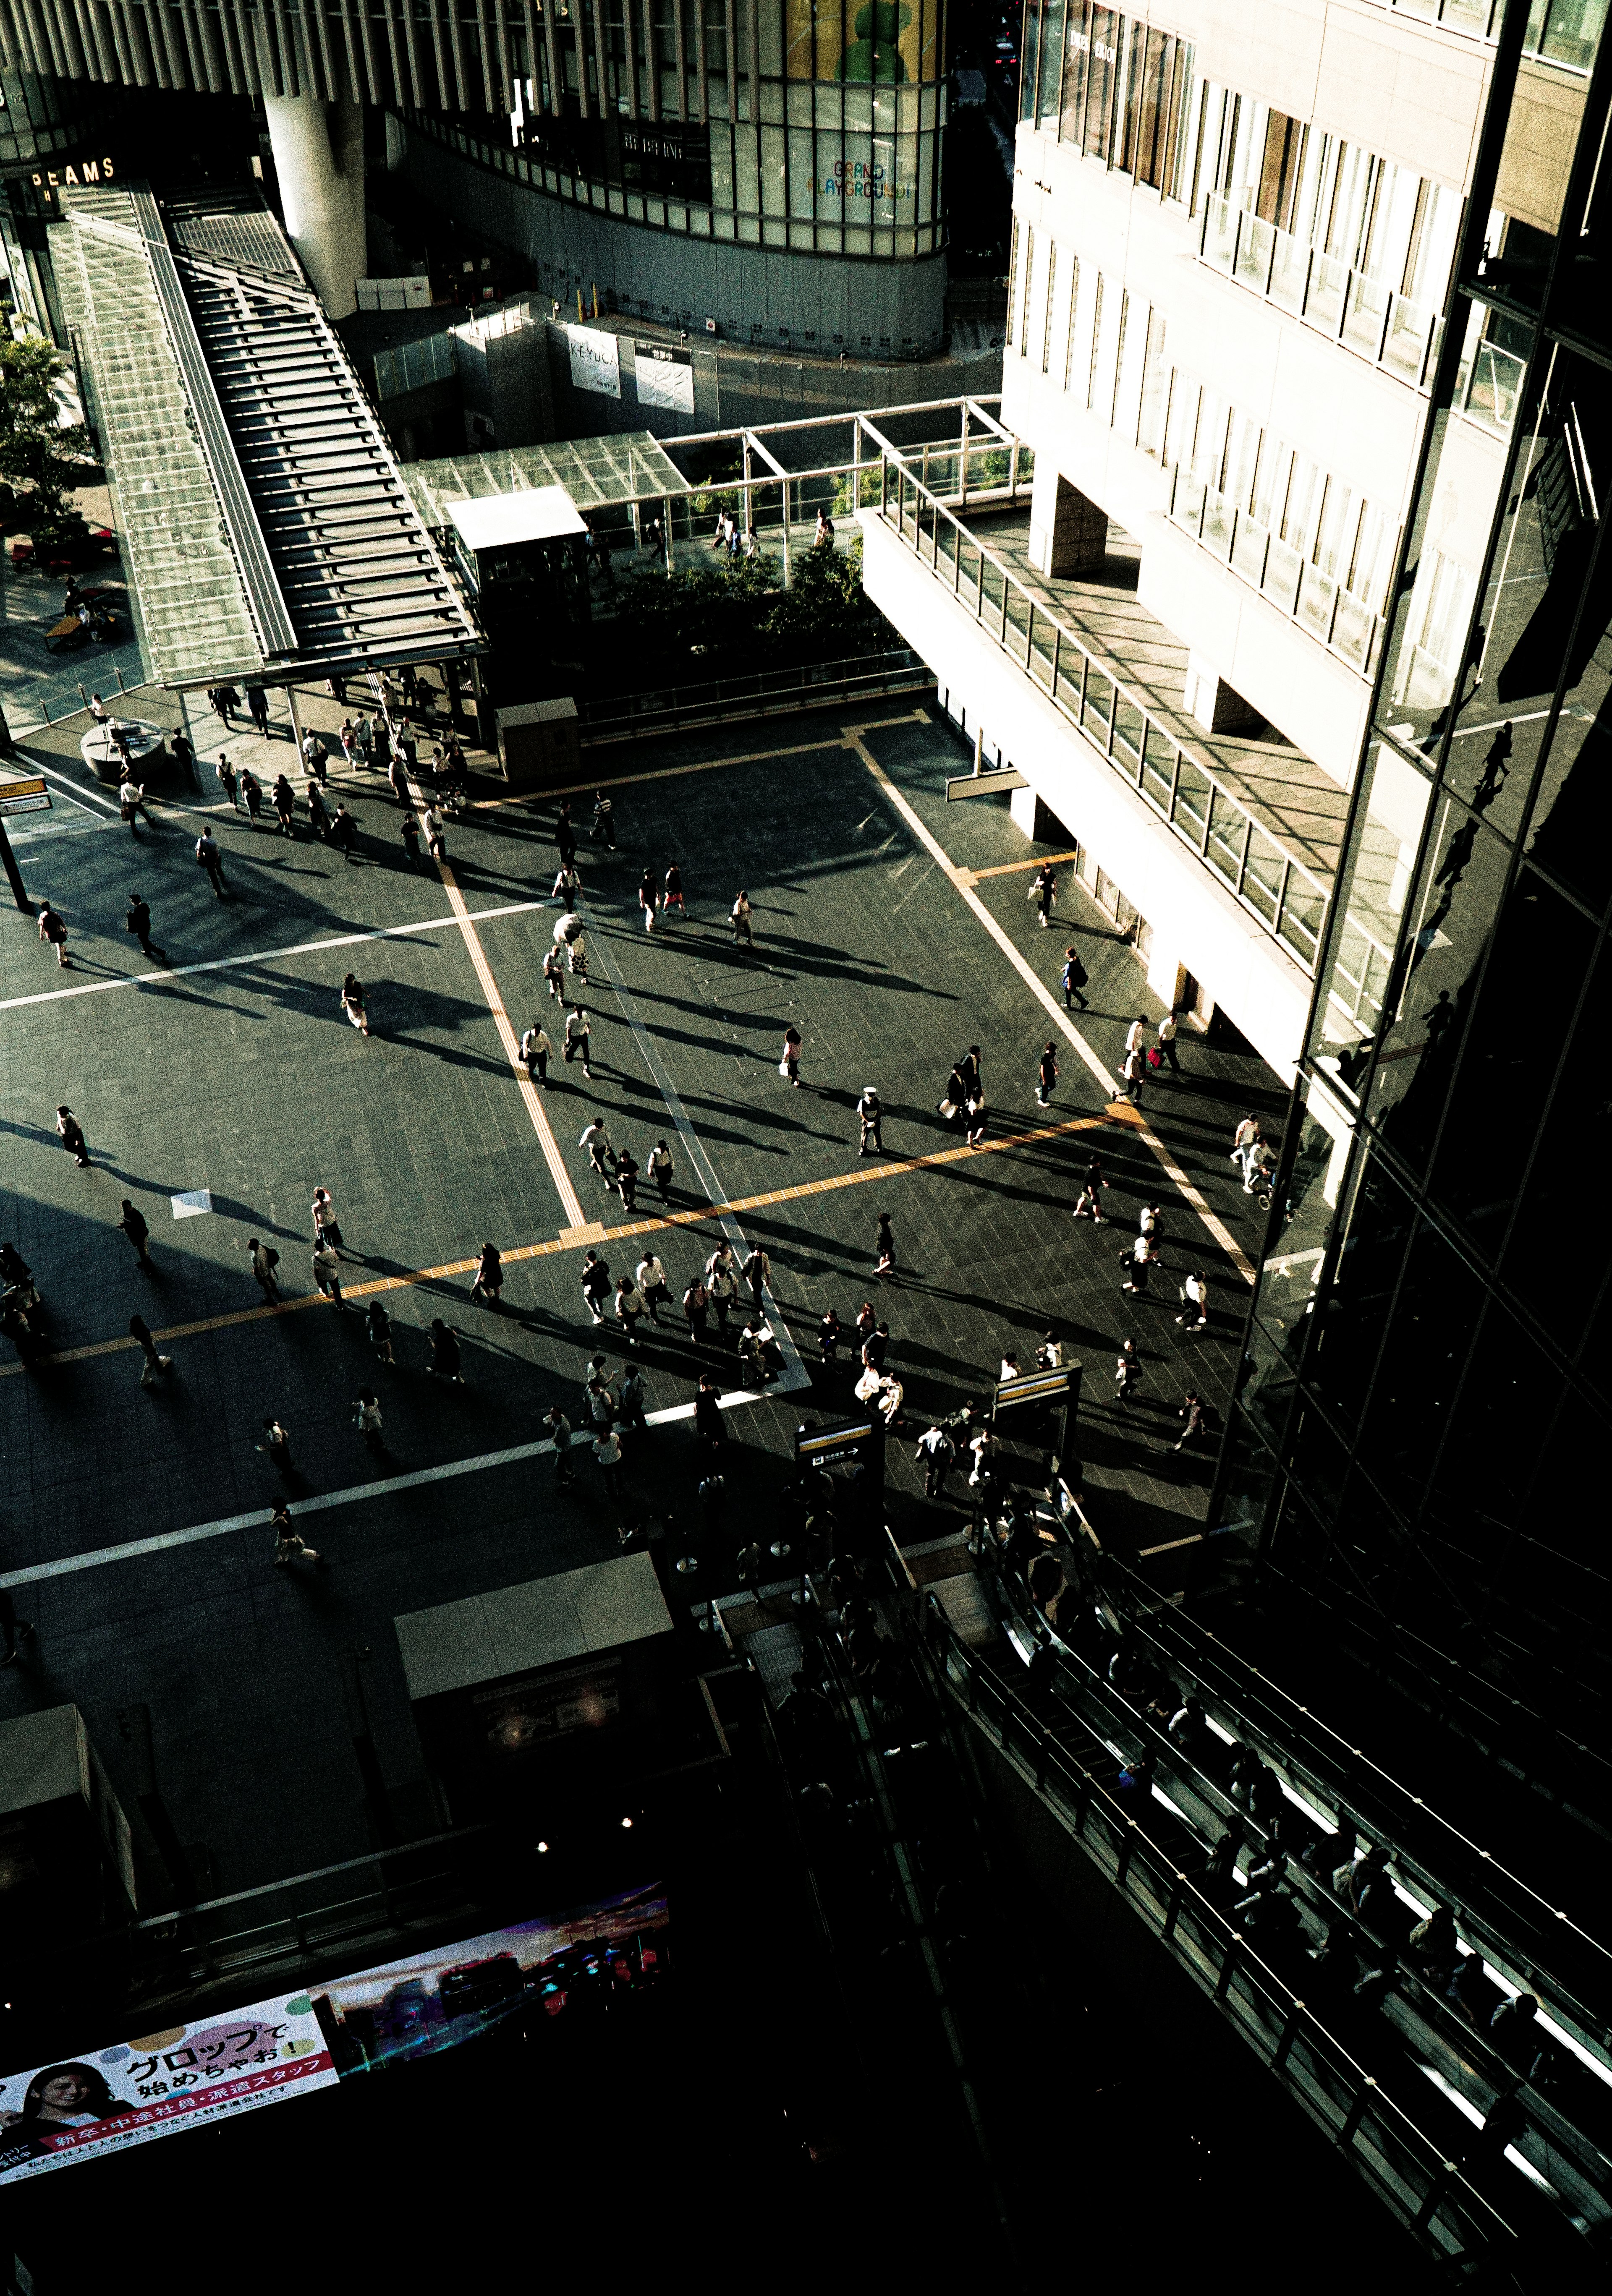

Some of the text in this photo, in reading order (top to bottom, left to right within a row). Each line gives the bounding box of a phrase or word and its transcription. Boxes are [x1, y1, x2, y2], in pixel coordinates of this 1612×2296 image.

[834, 161, 885, 180] GRAND
[571, 343, 618, 366] KEYUCA
[126, 2023, 289, 2082] グロップで
[55, 2059, 321, 2147] 新卒・中途社員・派遣スタッフ
